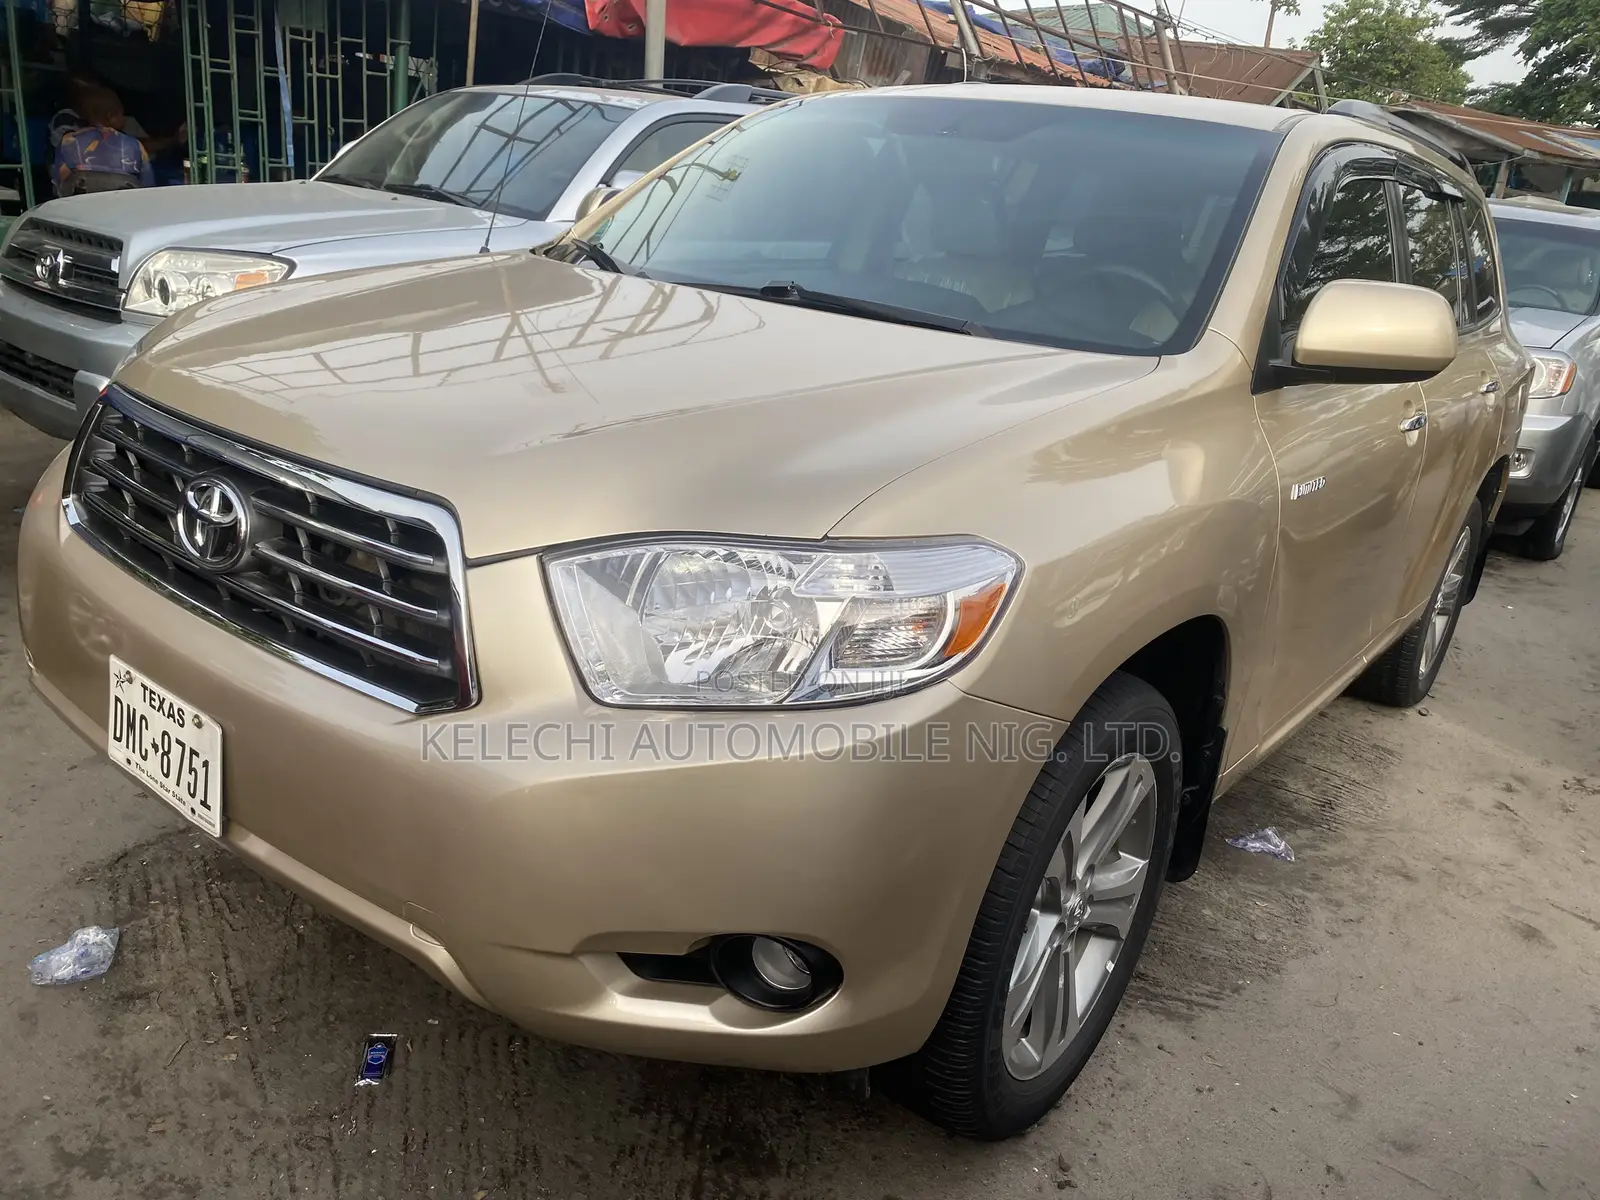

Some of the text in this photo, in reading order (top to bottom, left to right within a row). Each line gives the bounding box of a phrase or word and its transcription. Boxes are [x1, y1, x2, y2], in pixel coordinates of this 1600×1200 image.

[140, 682, 186, 728] TEXAS
[135, 762, 187, 807] The Lone Star State
